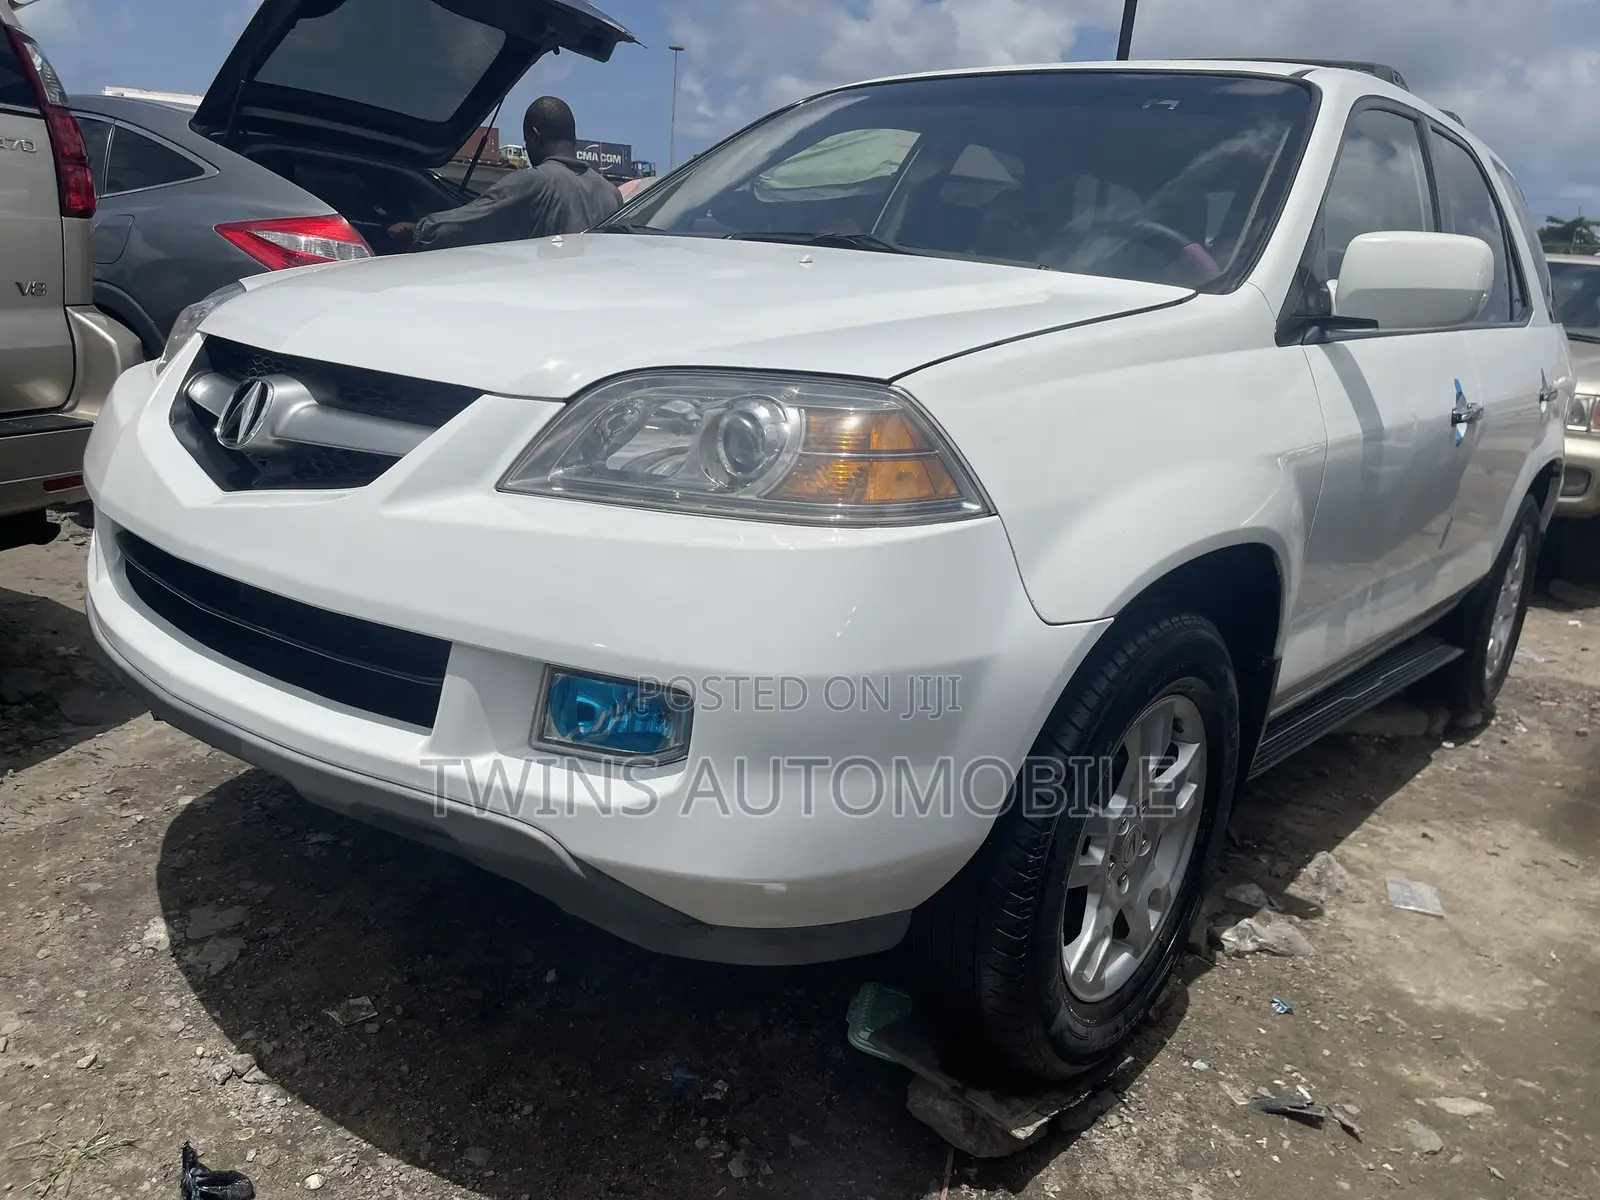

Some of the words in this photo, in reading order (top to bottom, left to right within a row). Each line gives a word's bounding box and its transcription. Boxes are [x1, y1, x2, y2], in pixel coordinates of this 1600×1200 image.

[576, 151, 599, 163] CMA
[600, 152, 622, 164] CGM
[16, 281, 47, 296] V8
